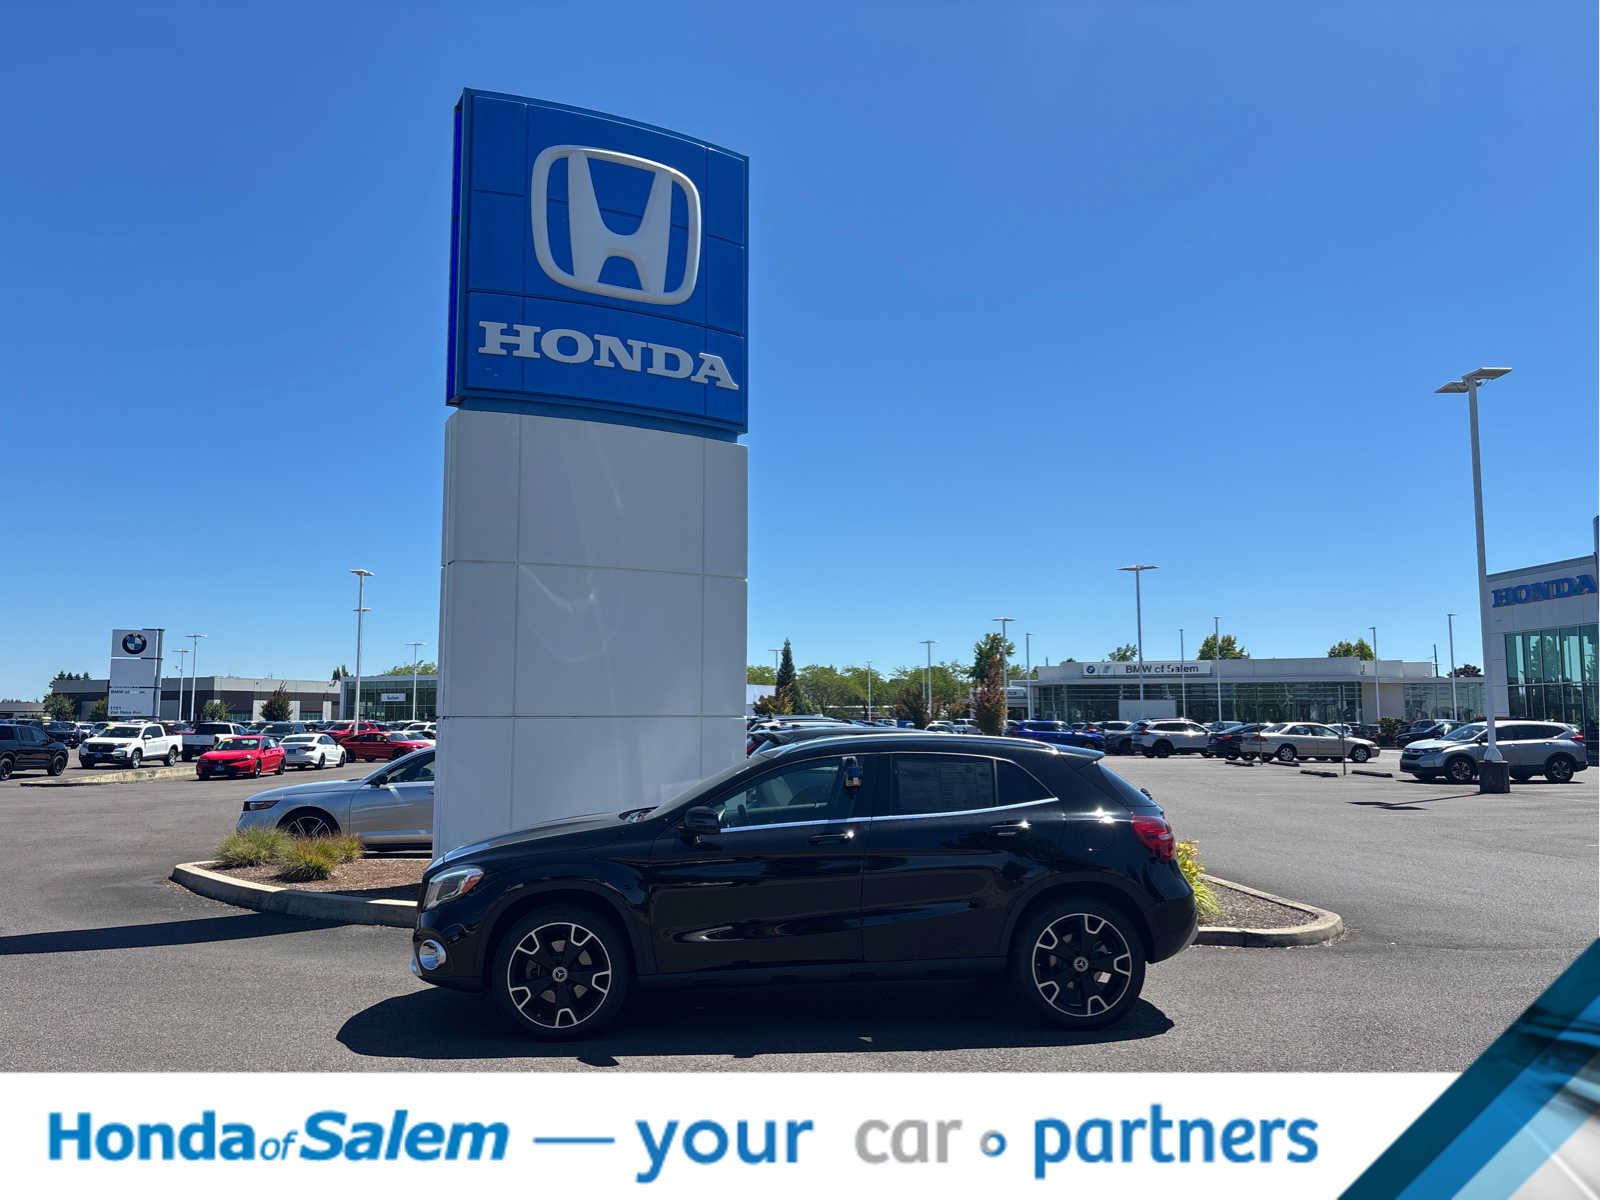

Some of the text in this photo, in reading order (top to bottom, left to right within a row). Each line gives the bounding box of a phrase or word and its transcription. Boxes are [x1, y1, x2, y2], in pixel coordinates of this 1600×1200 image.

[478, 320, 740, 391] HONDA
[1491, 574, 1598, 608] HONDA
[1125, 663, 1199, 674] BMW of Salem
